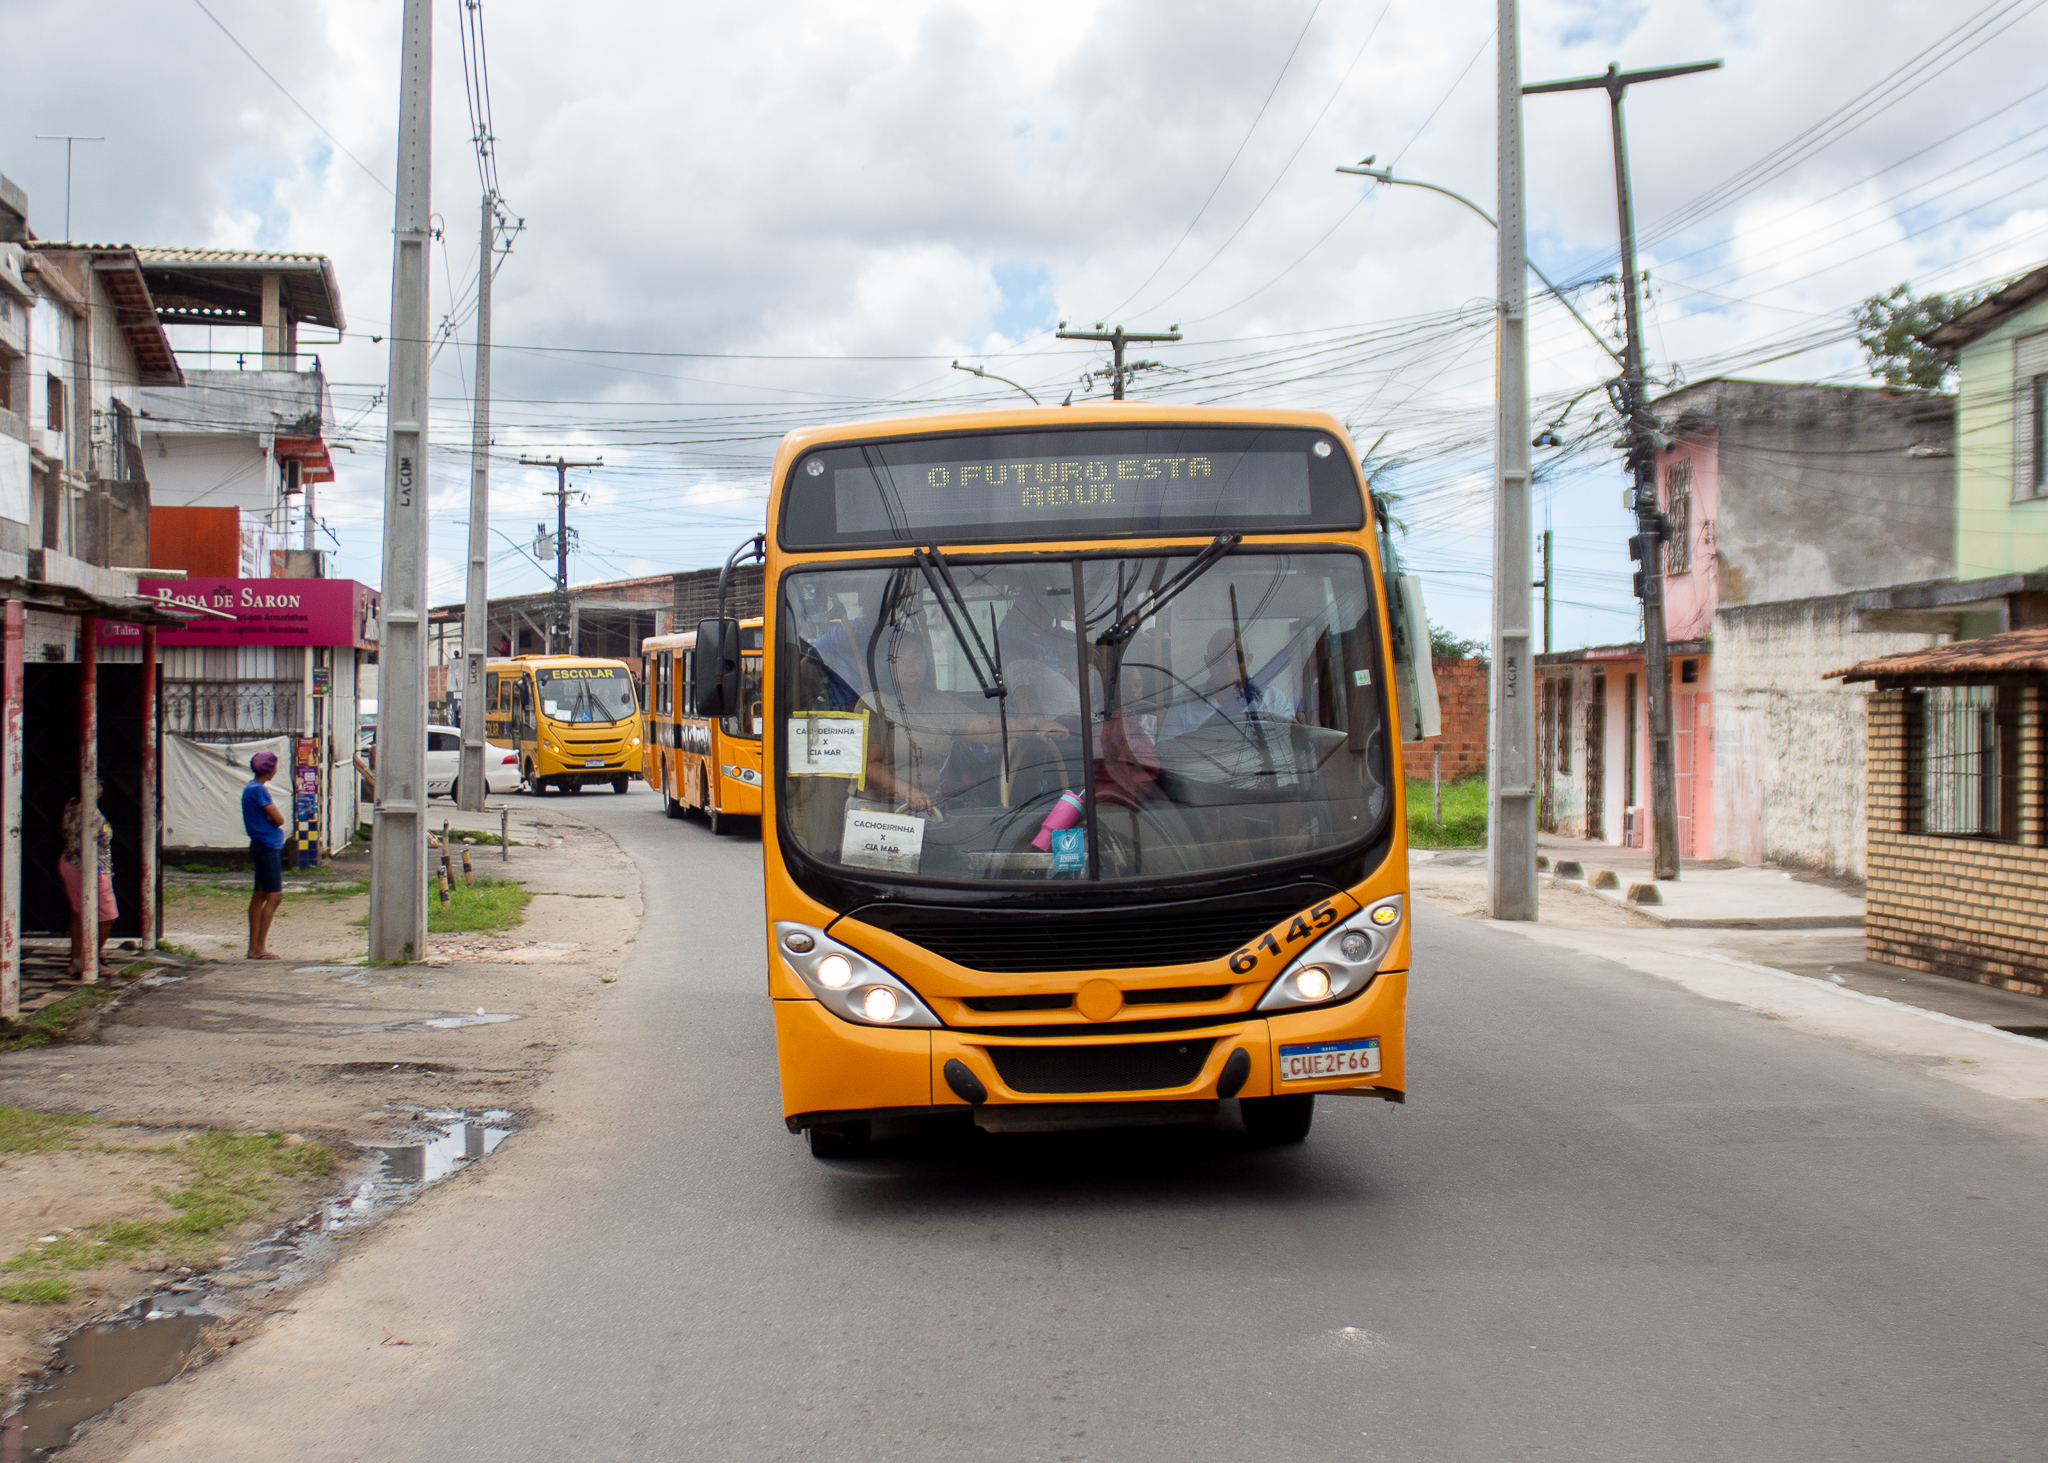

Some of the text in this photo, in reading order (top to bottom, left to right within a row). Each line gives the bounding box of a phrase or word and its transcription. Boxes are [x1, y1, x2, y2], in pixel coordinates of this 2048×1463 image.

[400, 457, 412, 506] LACOM
[928, 457, 1212, 487] O FUTURO ESTA
[1022, 484, 1116, 506] AQUI
[213, 594, 234, 608] DE
[240, 587, 301, 608] SARON
[112, 624, 140, 636] Talita
[552, 669, 615, 679] ESCOLAR
[1507, 656, 1517, 698] LACOM
[854, 820, 915, 834] CACHOEIRINHA
[865, 843, 899, 854] CIA MAR
[1229, 900, 1339, 975] 6145
[1290, 1051, 1370, 1075] CUE2F66
